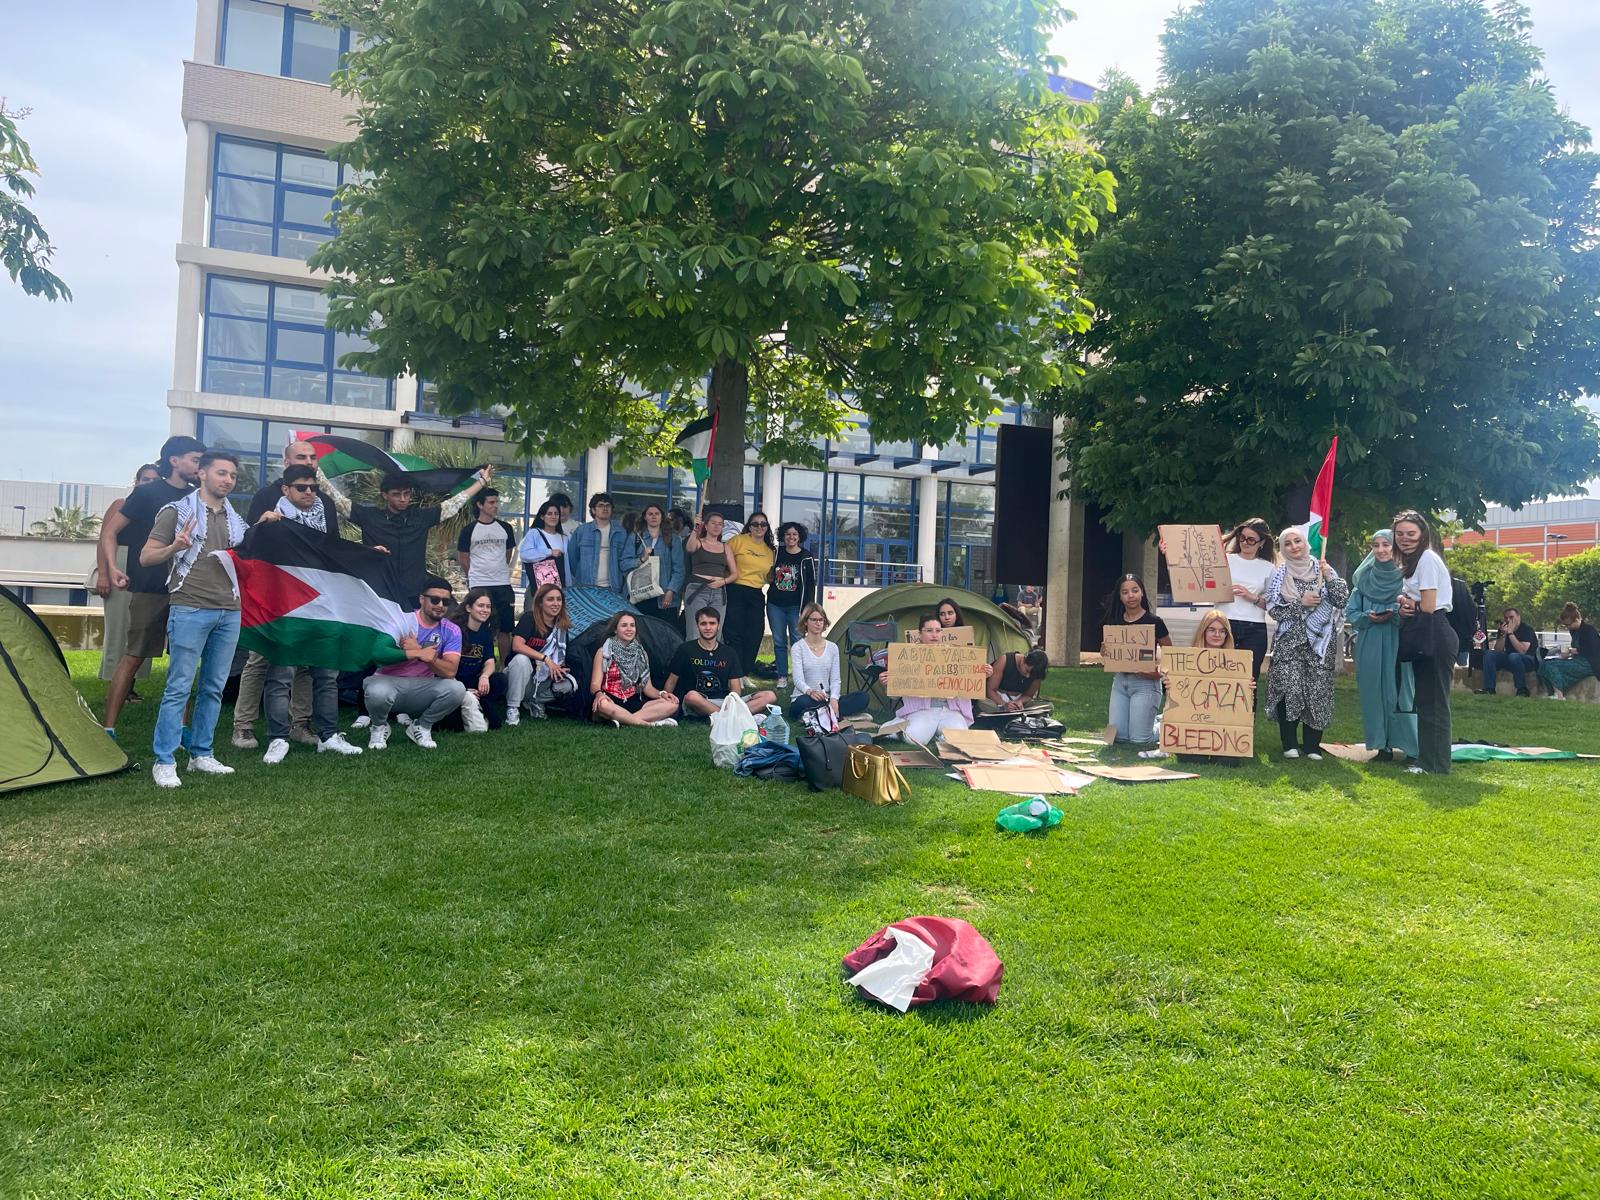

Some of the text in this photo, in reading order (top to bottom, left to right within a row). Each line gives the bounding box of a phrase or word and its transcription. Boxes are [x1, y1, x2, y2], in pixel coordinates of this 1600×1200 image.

[898, 647, 977, 664] ABYA YALA
[1164, 649, 1247, 675] THE Children
[937, 676, 983, 693] GENOCIDIO
[1176, 677, 1249, 712] of GAZA
[1190, 712, 1216, 723] are
